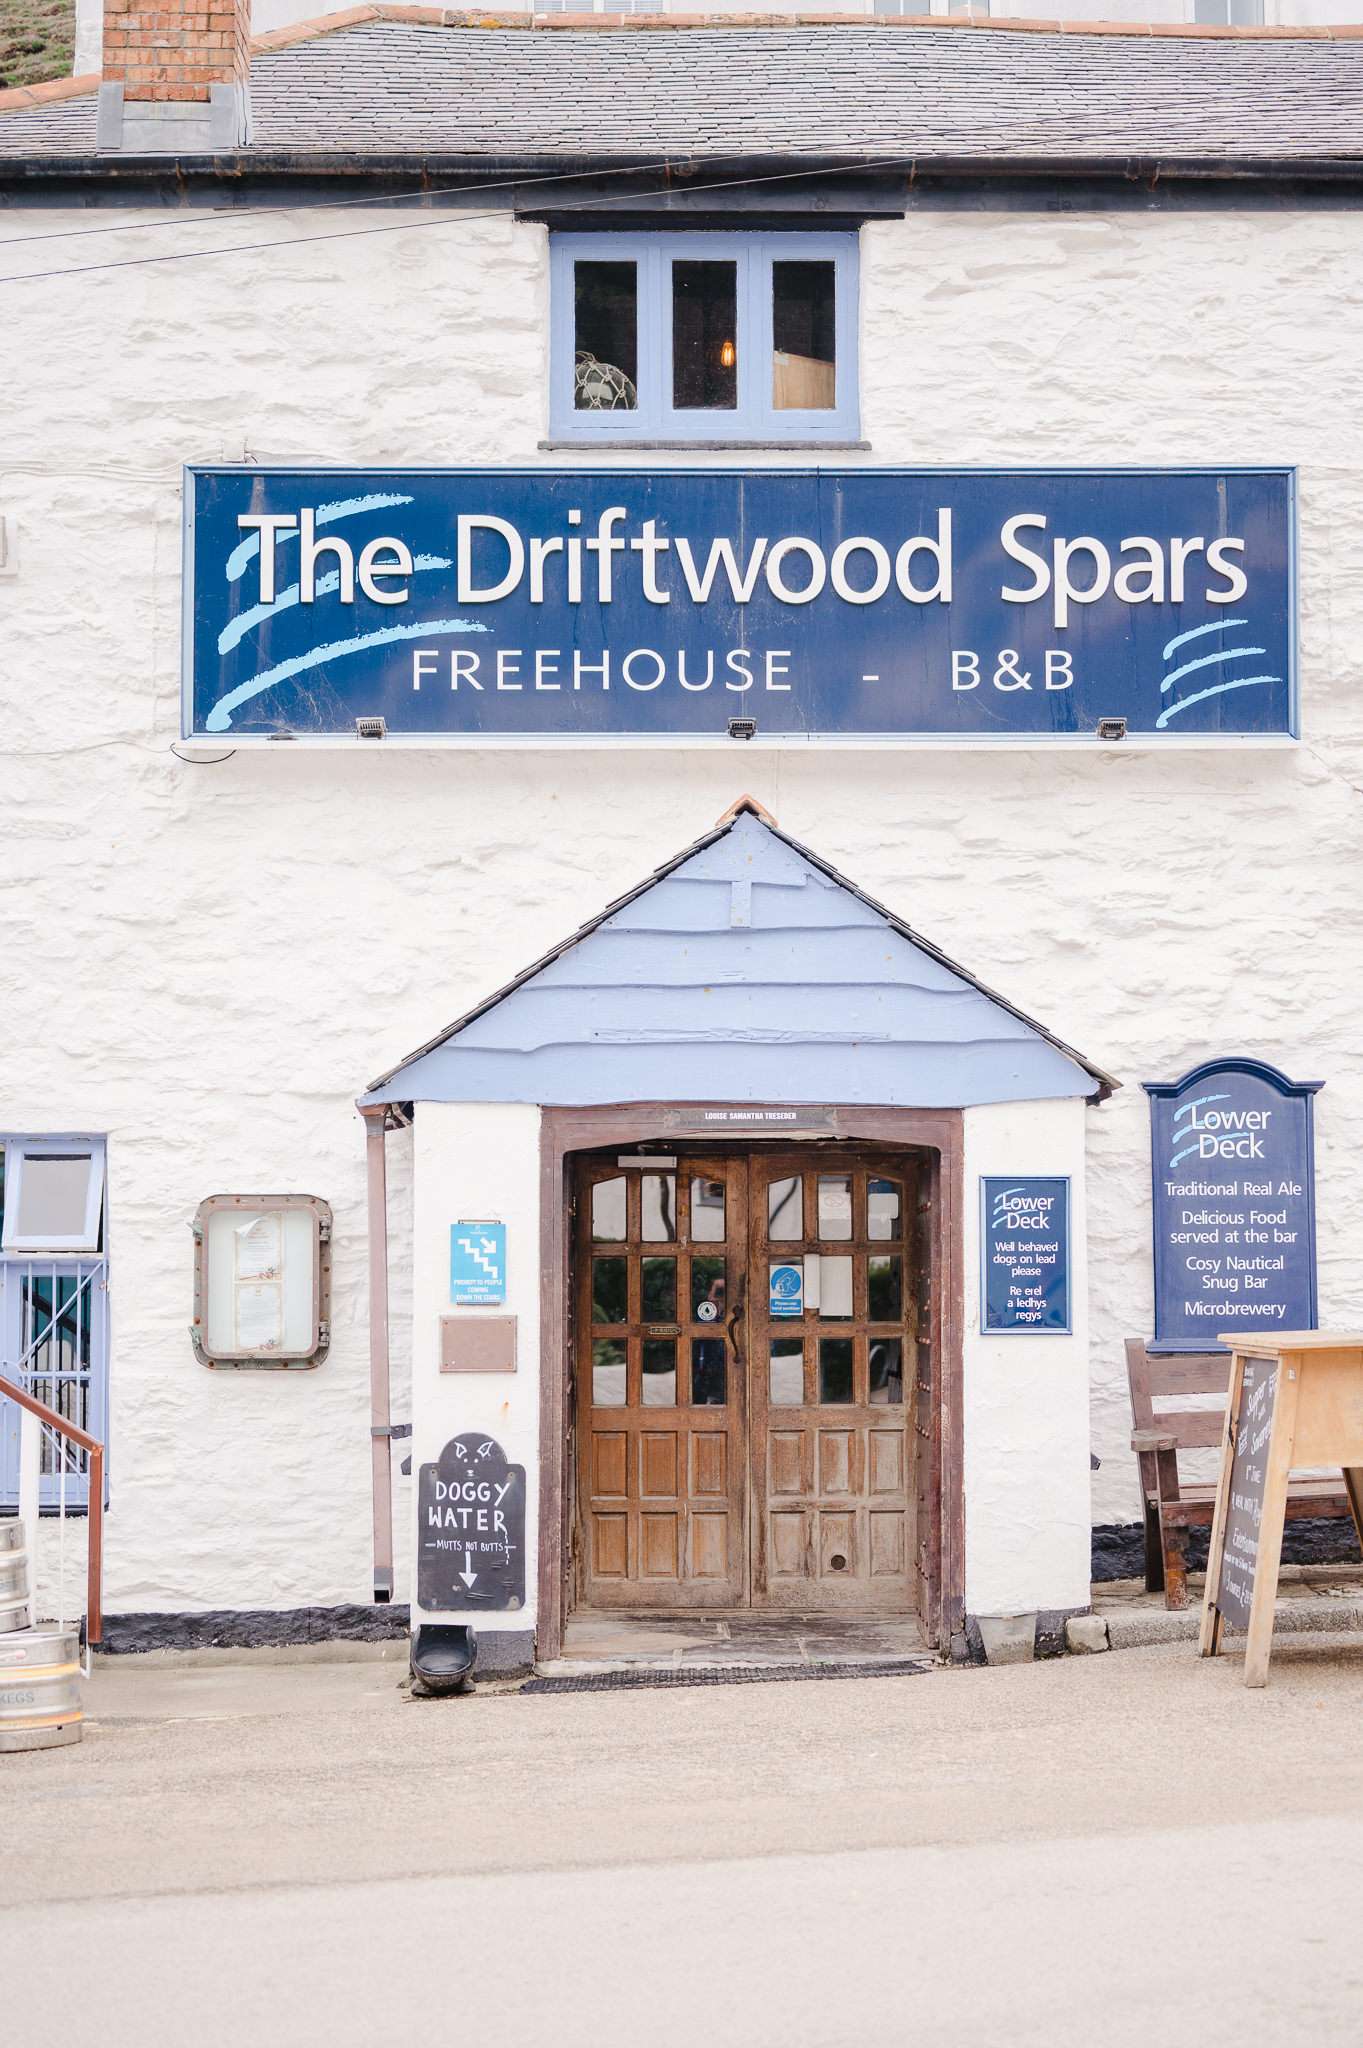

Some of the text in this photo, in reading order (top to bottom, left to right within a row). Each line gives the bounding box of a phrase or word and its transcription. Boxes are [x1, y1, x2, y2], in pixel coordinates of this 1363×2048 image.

[238, 507, 1248, 629] The Driftwood Spars
[412, 647, 792, 693] FREEHOUSE
[952, 649, 1073, 691] B&B
[1191, 1105, 1272, 1130] Lower
[1199, 1132, 1264, 1158] Deck
[1165, 1181, 1301, 1195] Traditional Real Ale
[1002, 1193, 1054, 1210] Lower
[1007, 1212, 1050, 1229] Deck
[1183, 1210, 1286, 1224] Delicious Food
[1171, 1229, 1297, 1243] served at the bar
[995, 1242, 1058, 1251] Well behaved
[993, 1254, 1055, 1266] dogs on lead
[1186, 1256, 1283, 1274] Cosy Nautical
[1012, 1266, 1041, 1278] please
[1010, 1286, 1022, 1295] Re
[1202, 1275, 1268, 1292] Snug Bar
[1016, 1311, 1041, 1321] regys
[1185, 1301, 1285, 1318] Microbrewery
[435, 1481, 510, 1506] DOGGY
[428, 1506, 507, 1531] WATER
[437, 1540, 503, 1552] MUTTS NOT BUTTS
